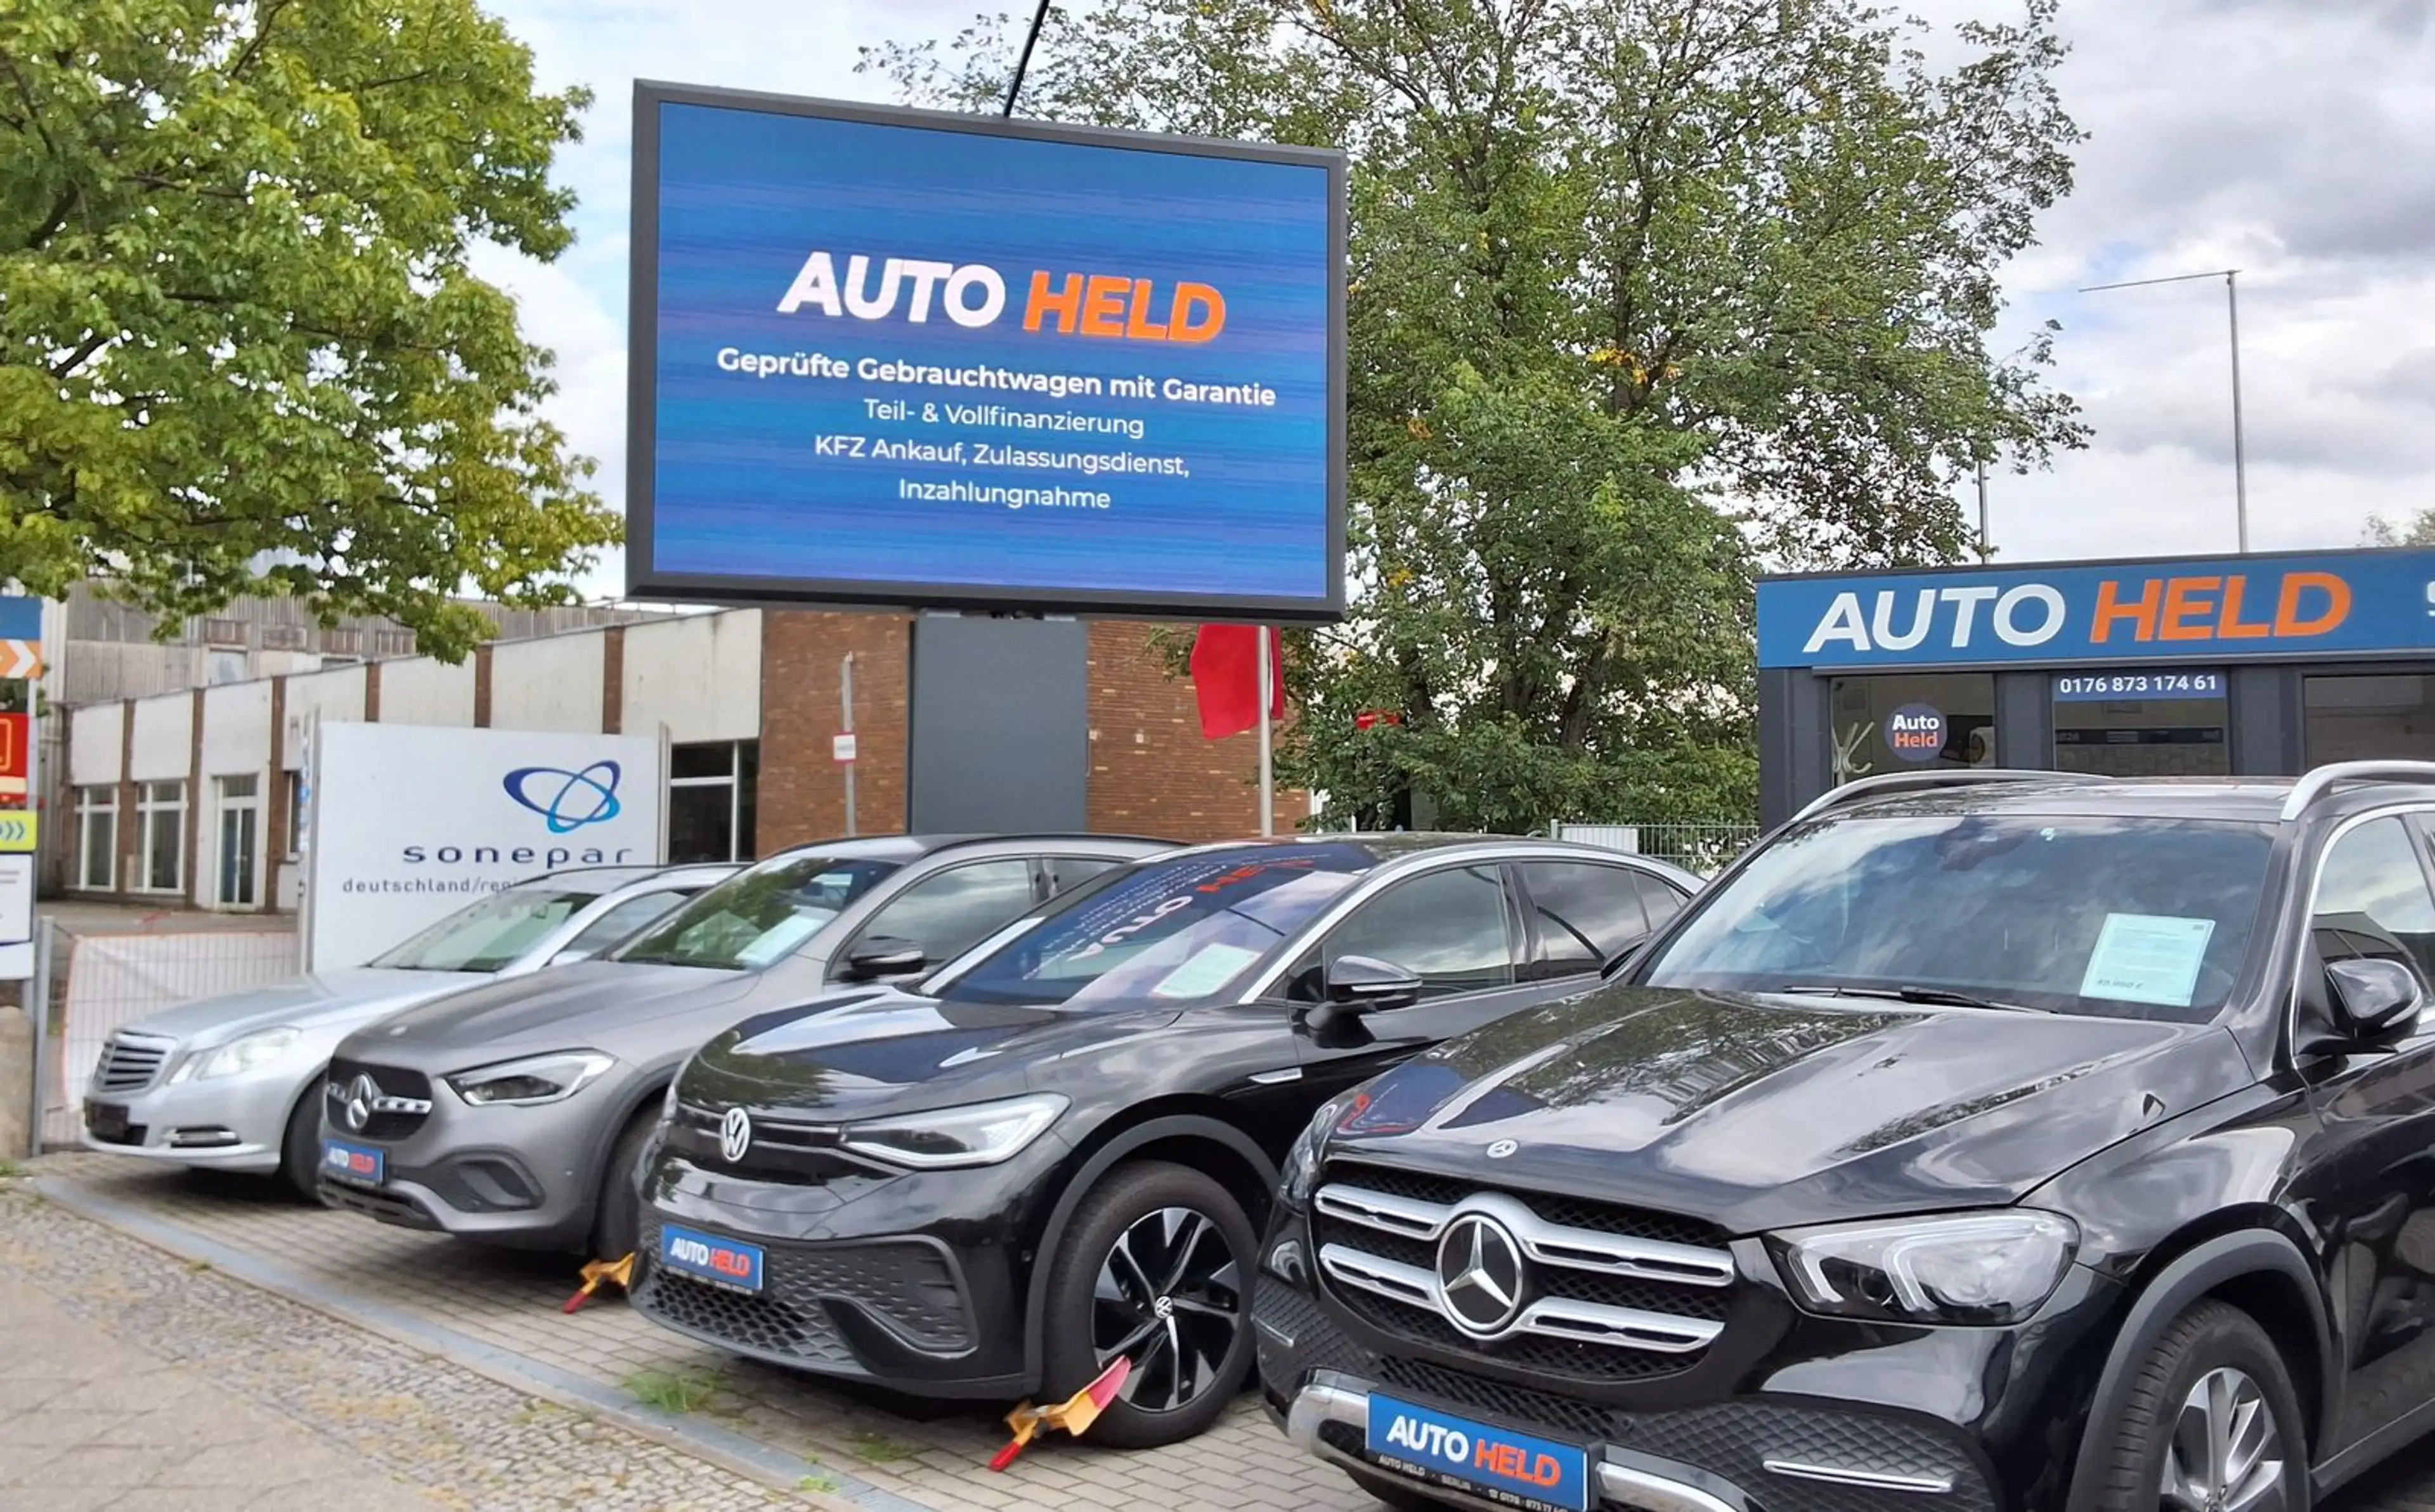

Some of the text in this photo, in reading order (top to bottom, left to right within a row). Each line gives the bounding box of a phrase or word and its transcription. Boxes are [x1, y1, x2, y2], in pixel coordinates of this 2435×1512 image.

[777, 252, 1227, 344] AUTO HELD
[717, 347, 1276, 406] Geprüfte Gebrauchtwagen mit Garantie
[864, 398, 1145, 439] Teil- & Vollfinanzierung
[815, 436, 1190, 477] KFZ Ankauf, Zulassungsdienst,
[900, 479, 1111, 509] Inzahlungnahme
[1802, 583, 2067, 653] AUTO
[2089, 571, 2352, 644] HELD
[2060, 675, 2216, 693] 0176 873 174 61
[1892, 714, 1940, 731] Auto
[1894, 731, 1938, 748] Held
[403, 846, 632, 870] sonepar
[670, 1237, 751, 1277] AUTO HELD
[1386, 1415, 1562, 1487] AUTO HELD
